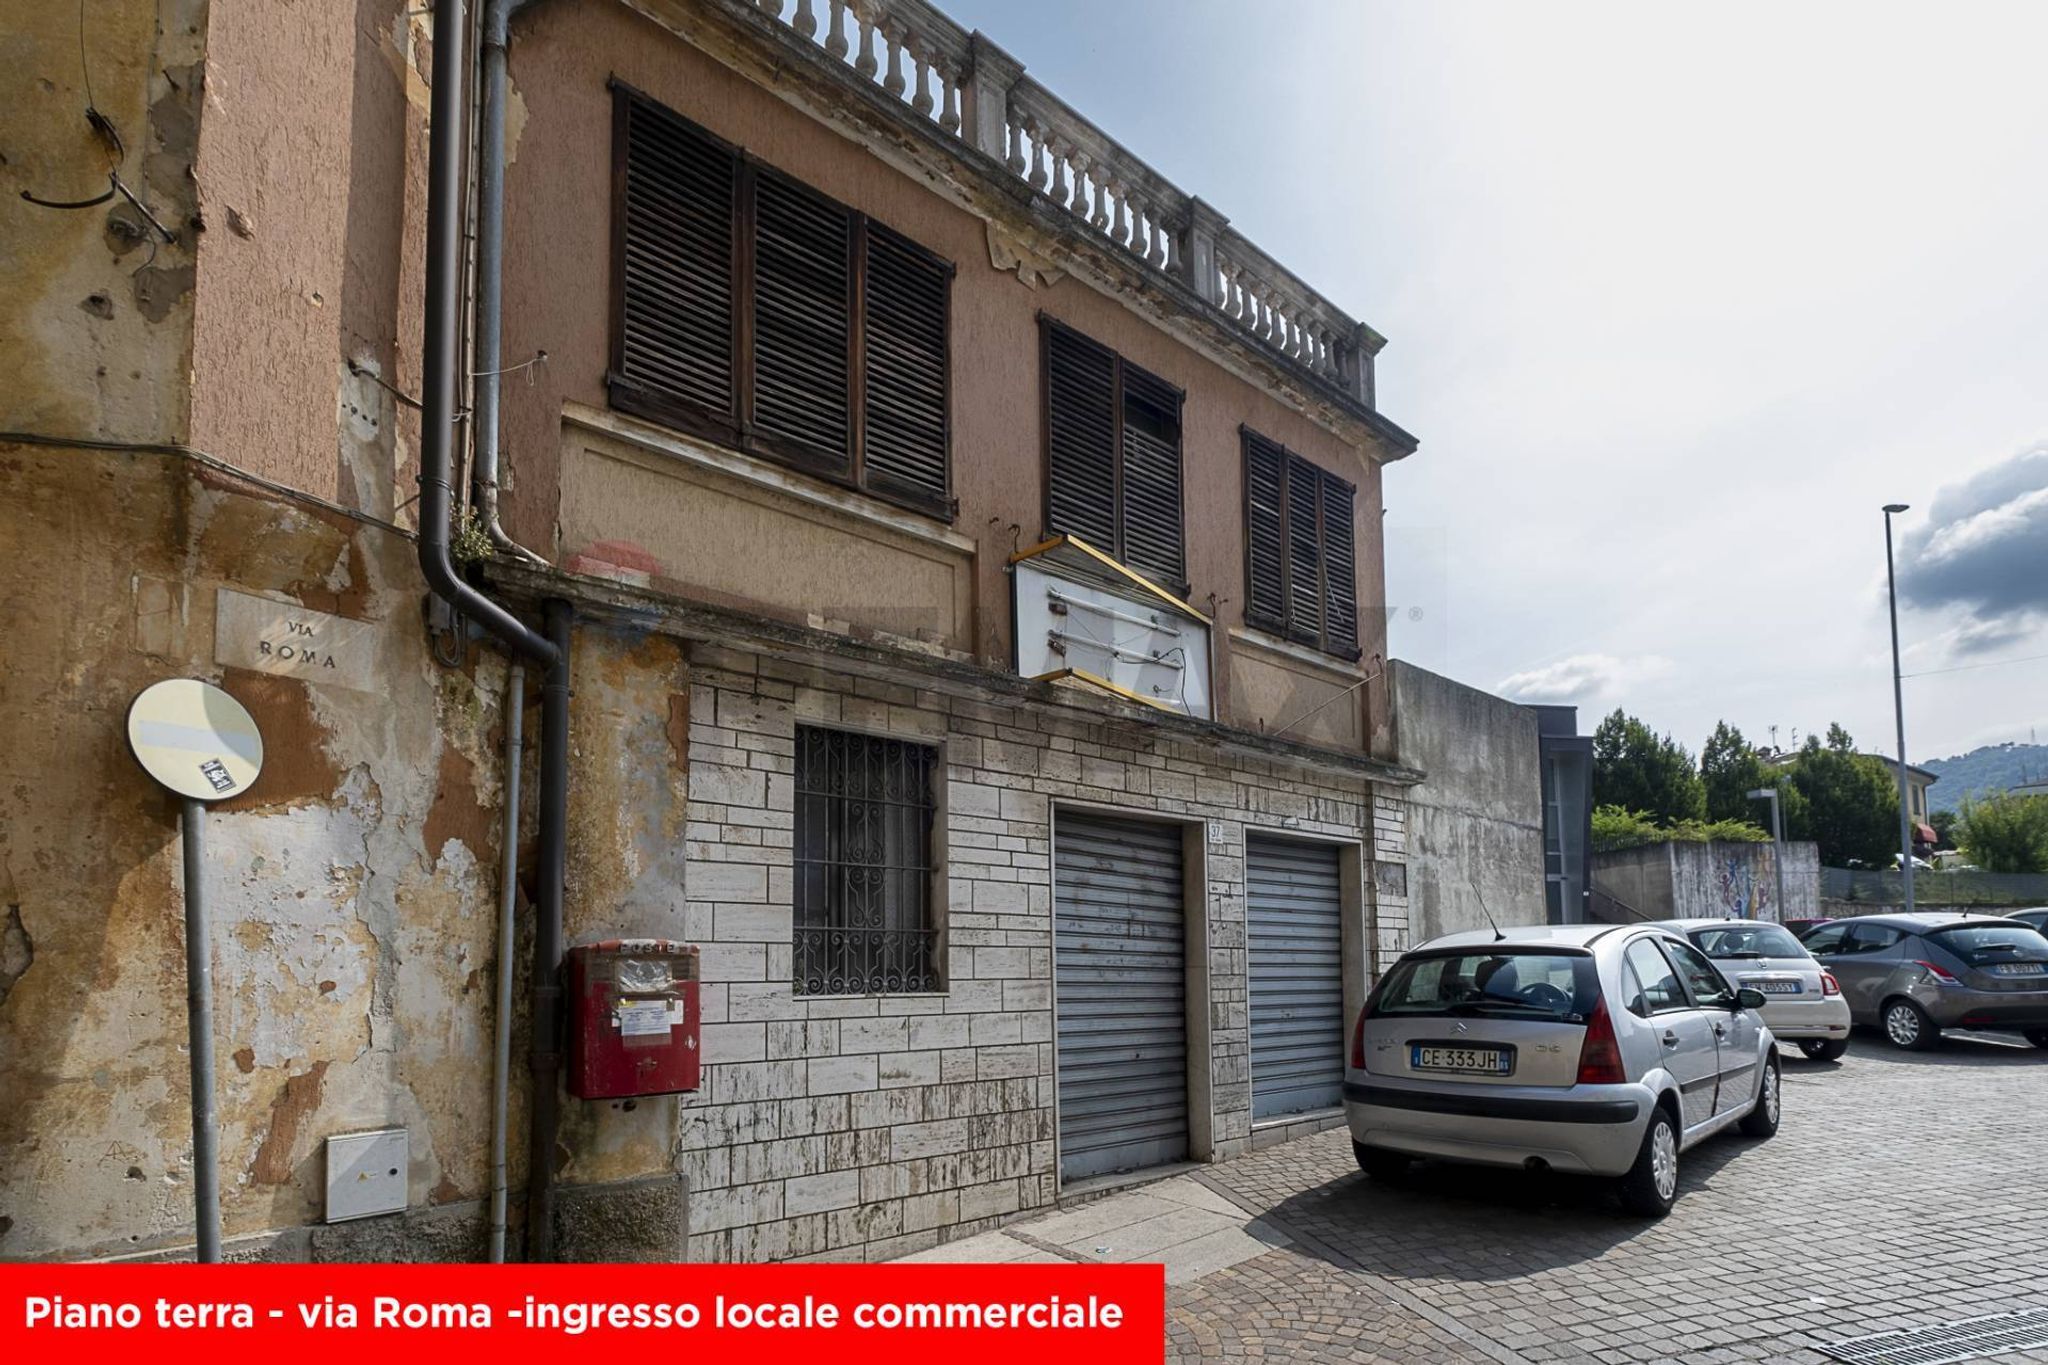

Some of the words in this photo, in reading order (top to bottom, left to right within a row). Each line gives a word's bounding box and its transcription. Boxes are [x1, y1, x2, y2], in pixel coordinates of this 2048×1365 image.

[288, 621, 314, 637] VIA
[260, 640, 336, 669] ROMA
[1211, 825, 1221, 838] 37
[1422, 1049, 1440, 1065] CE
[1446, 1050, 1497, 1069] 333JH
